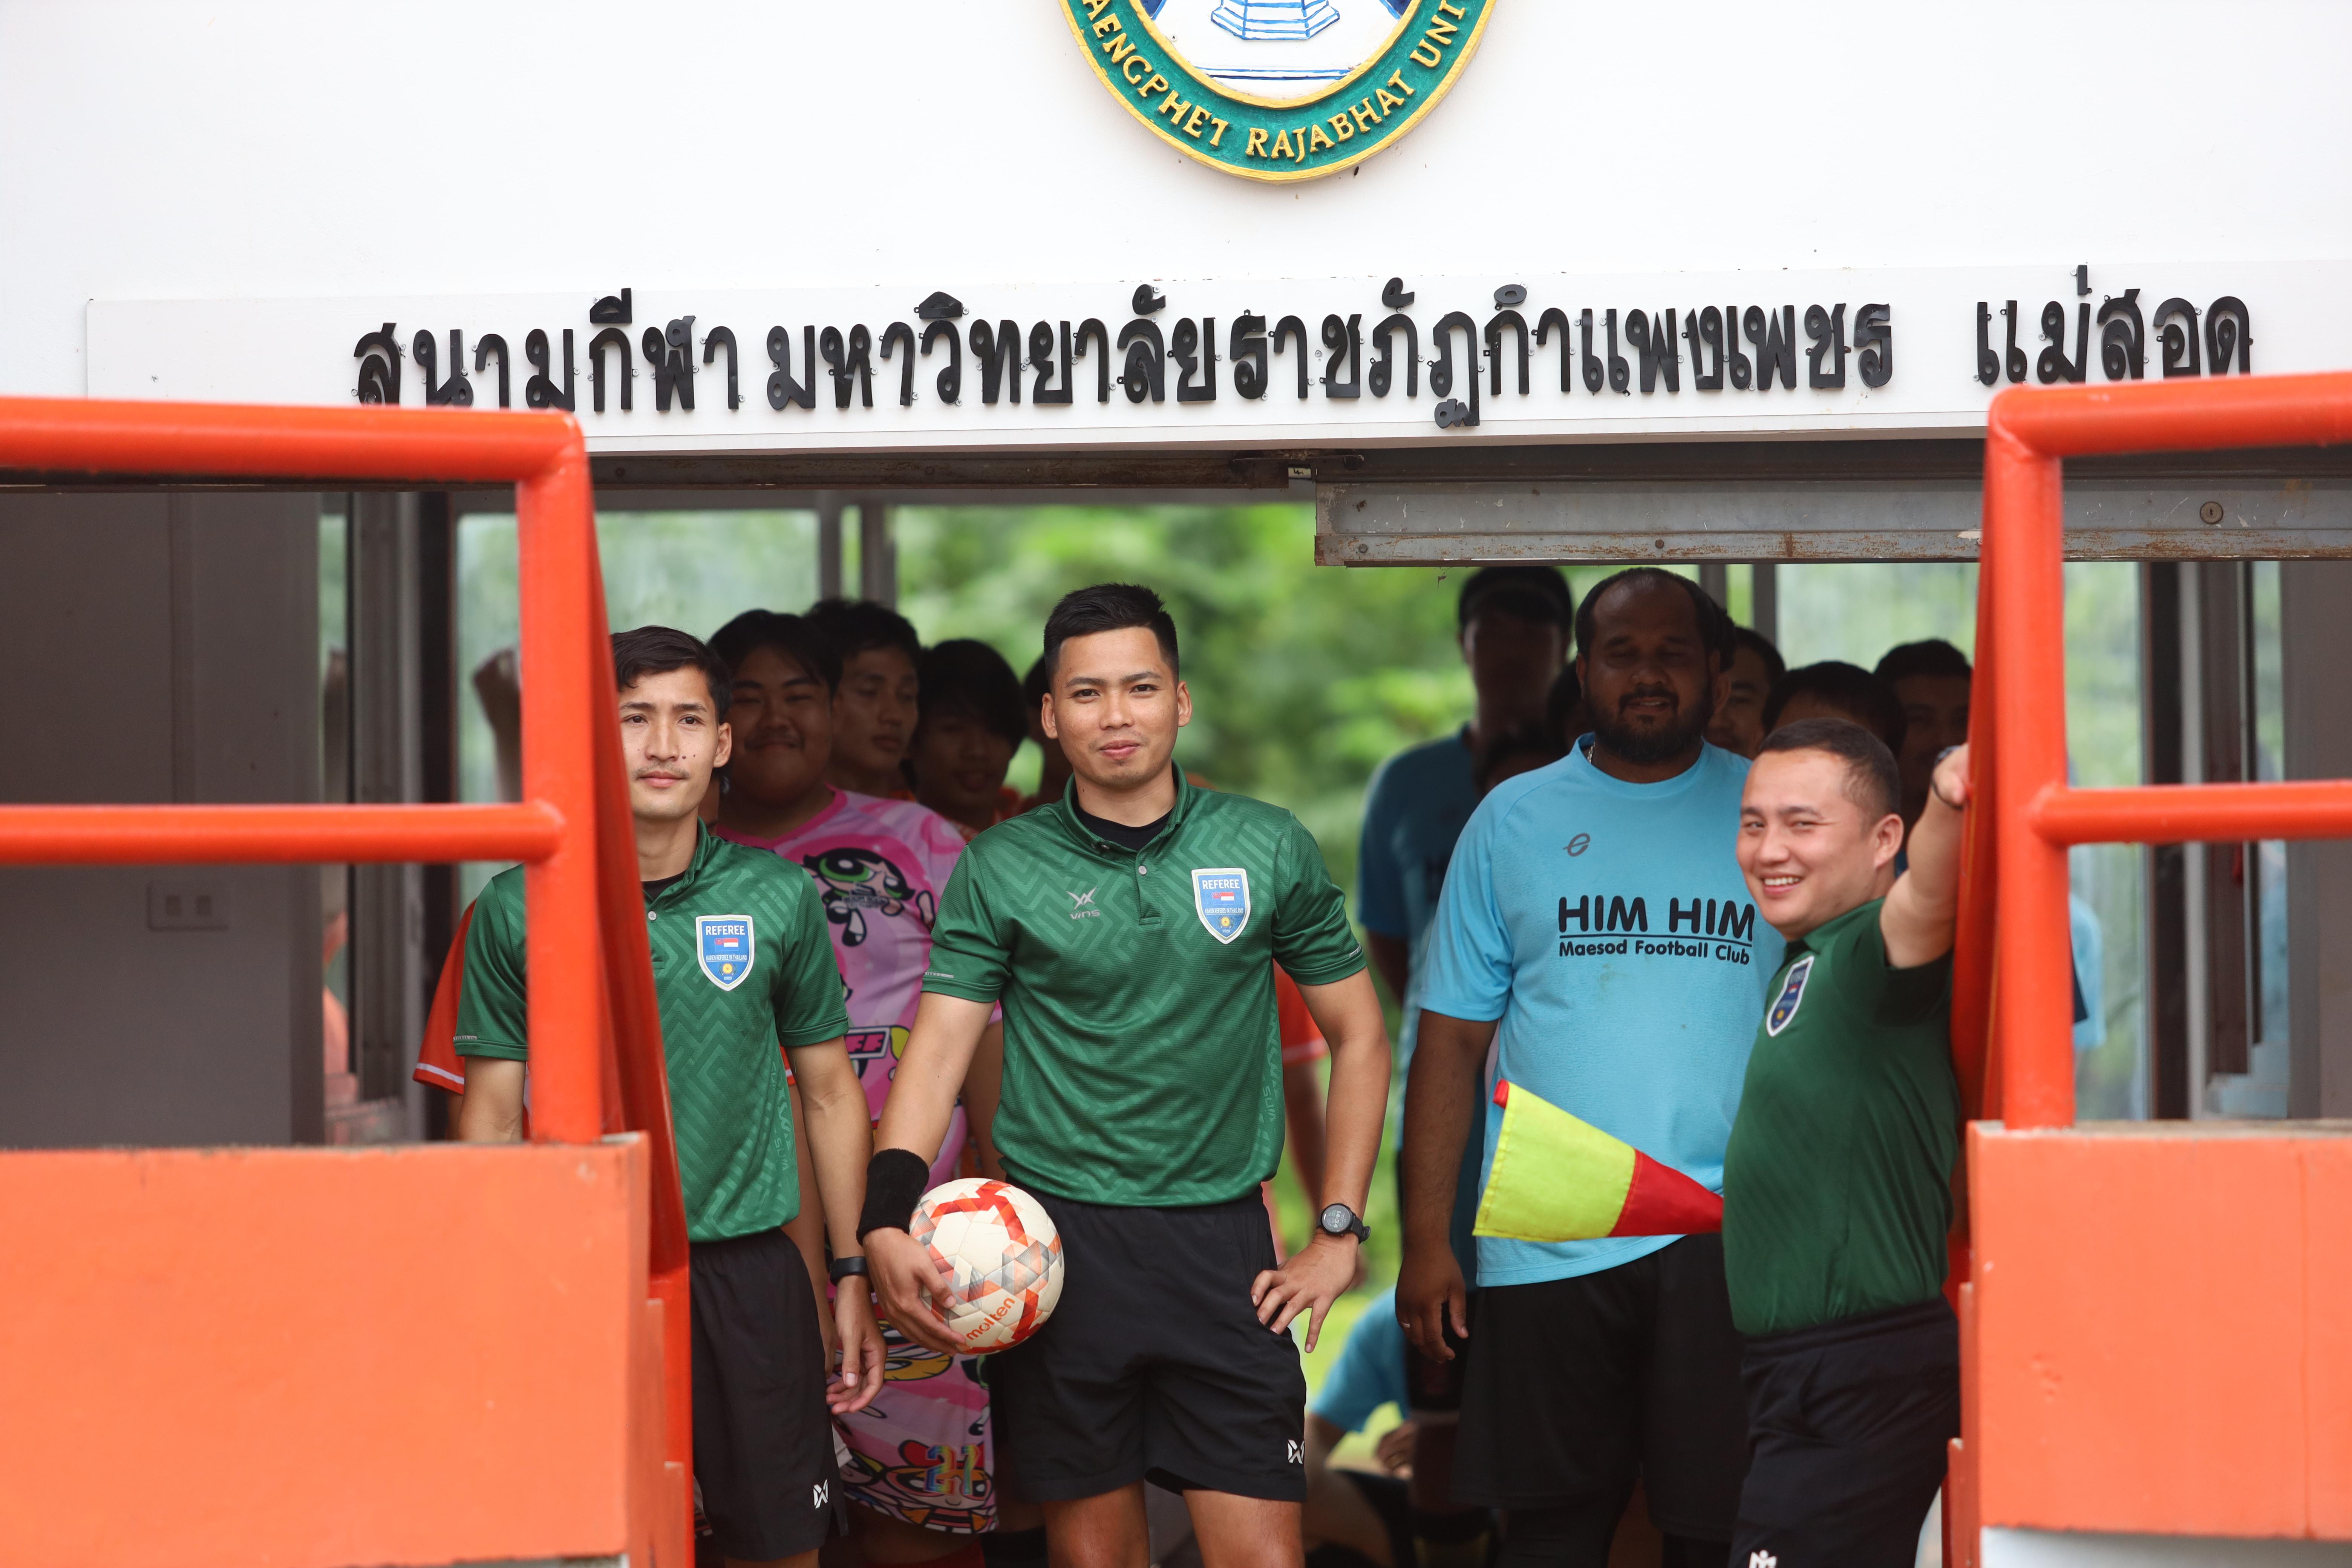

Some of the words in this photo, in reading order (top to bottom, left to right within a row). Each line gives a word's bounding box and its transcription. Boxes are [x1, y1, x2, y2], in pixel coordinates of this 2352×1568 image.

[1245, 69, 1415, 163] RAJABHAT
[1977, 265, 2253, 384] แม่สอด
[1202, 879, 1240, 890] REFEREE
[705, 925, 745, 935] REFEREE
[1559, 895, 1648, 933] HIM
[1669, 897, 1755, 942] HIM
[1559, 939, 1627, 957] Maesod
[1635, 940, 1708, 958] Football
[1715, 945, 1750, 965] Club
[966, 1297, 1015, 1341] molten
